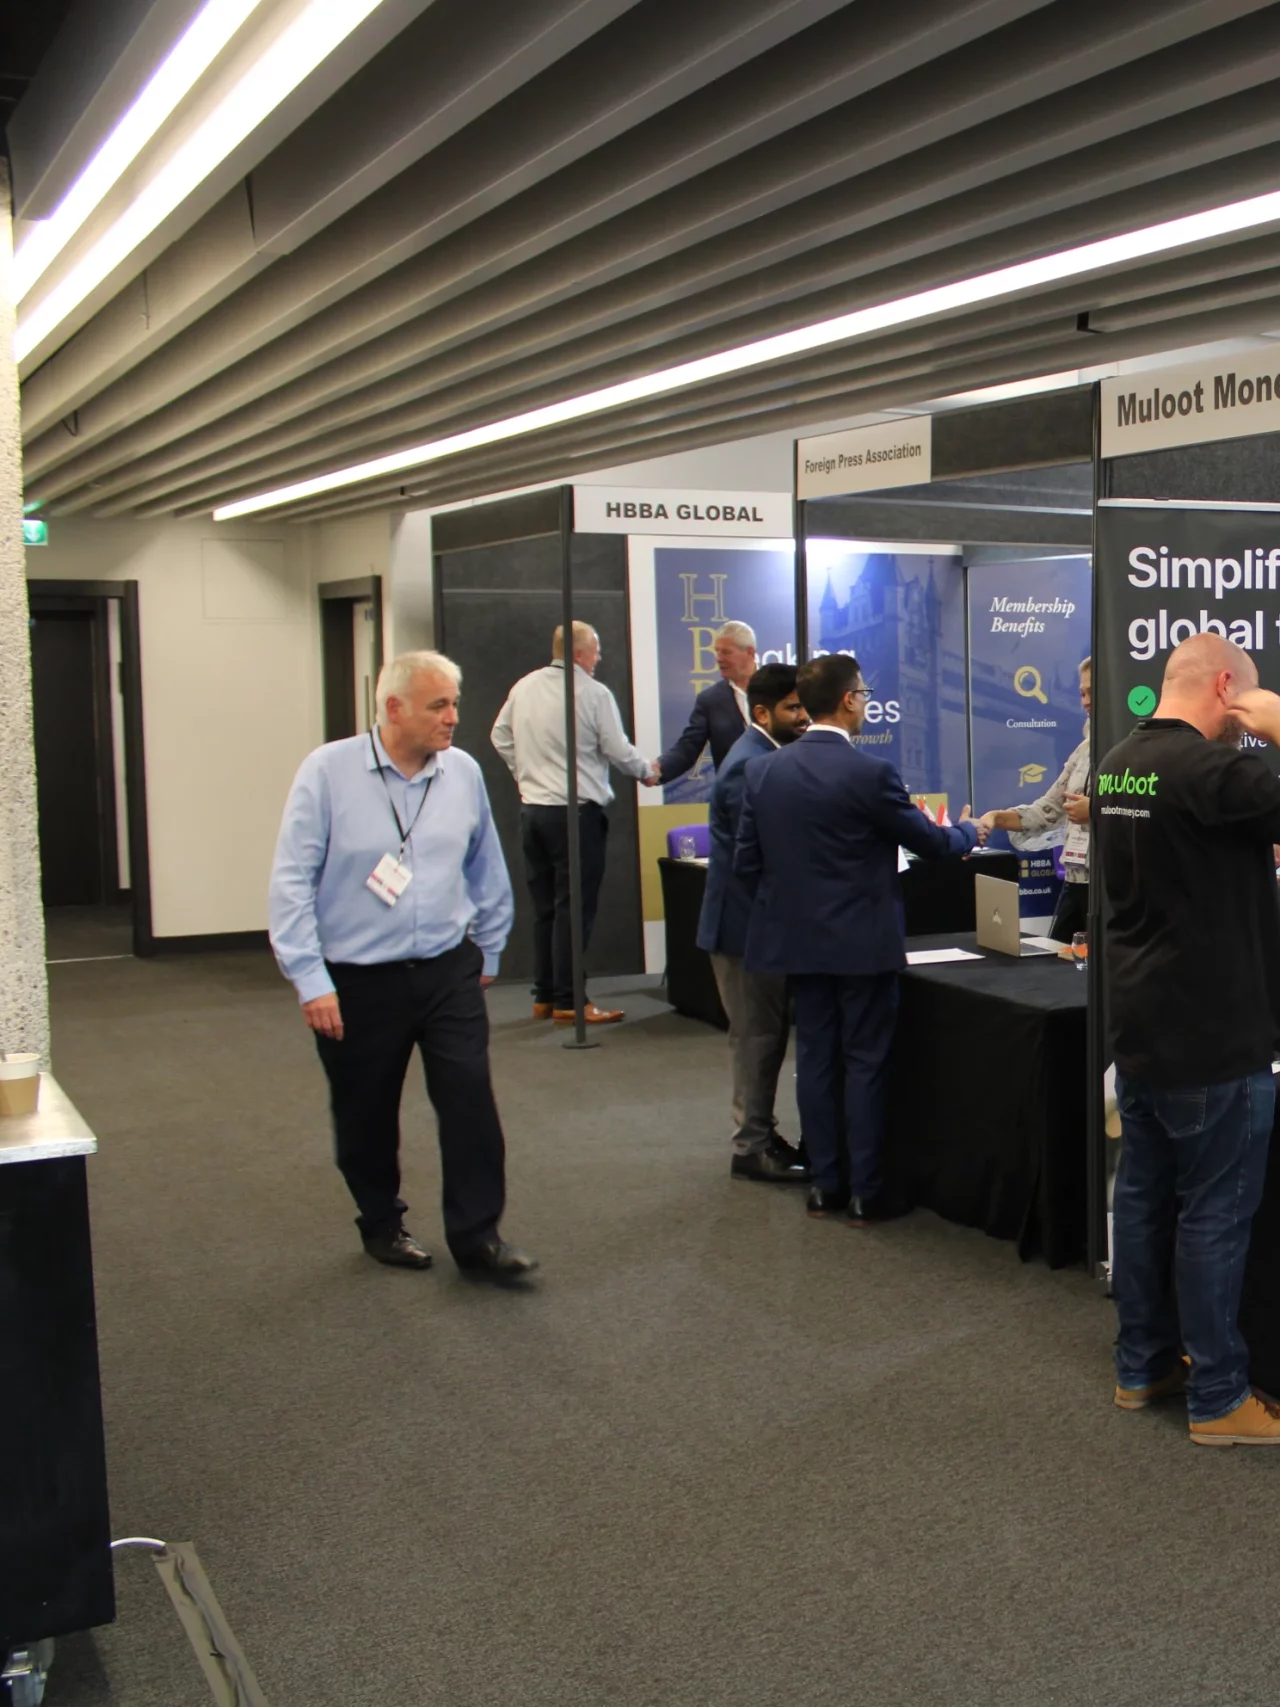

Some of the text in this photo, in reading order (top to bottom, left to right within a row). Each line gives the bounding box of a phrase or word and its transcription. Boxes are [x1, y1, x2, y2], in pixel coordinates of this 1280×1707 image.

[1117, 380, 1204, 427] Muloot
[805, 443, 921, 474] Foreign Press Association
[606, 502, 763, 522] HBBA GLOBAL
[989, 597, 1076, 618] Membership
[990, 617, 1045, 638] Benefits
[1006, 718, 1057, 729] Consultation
